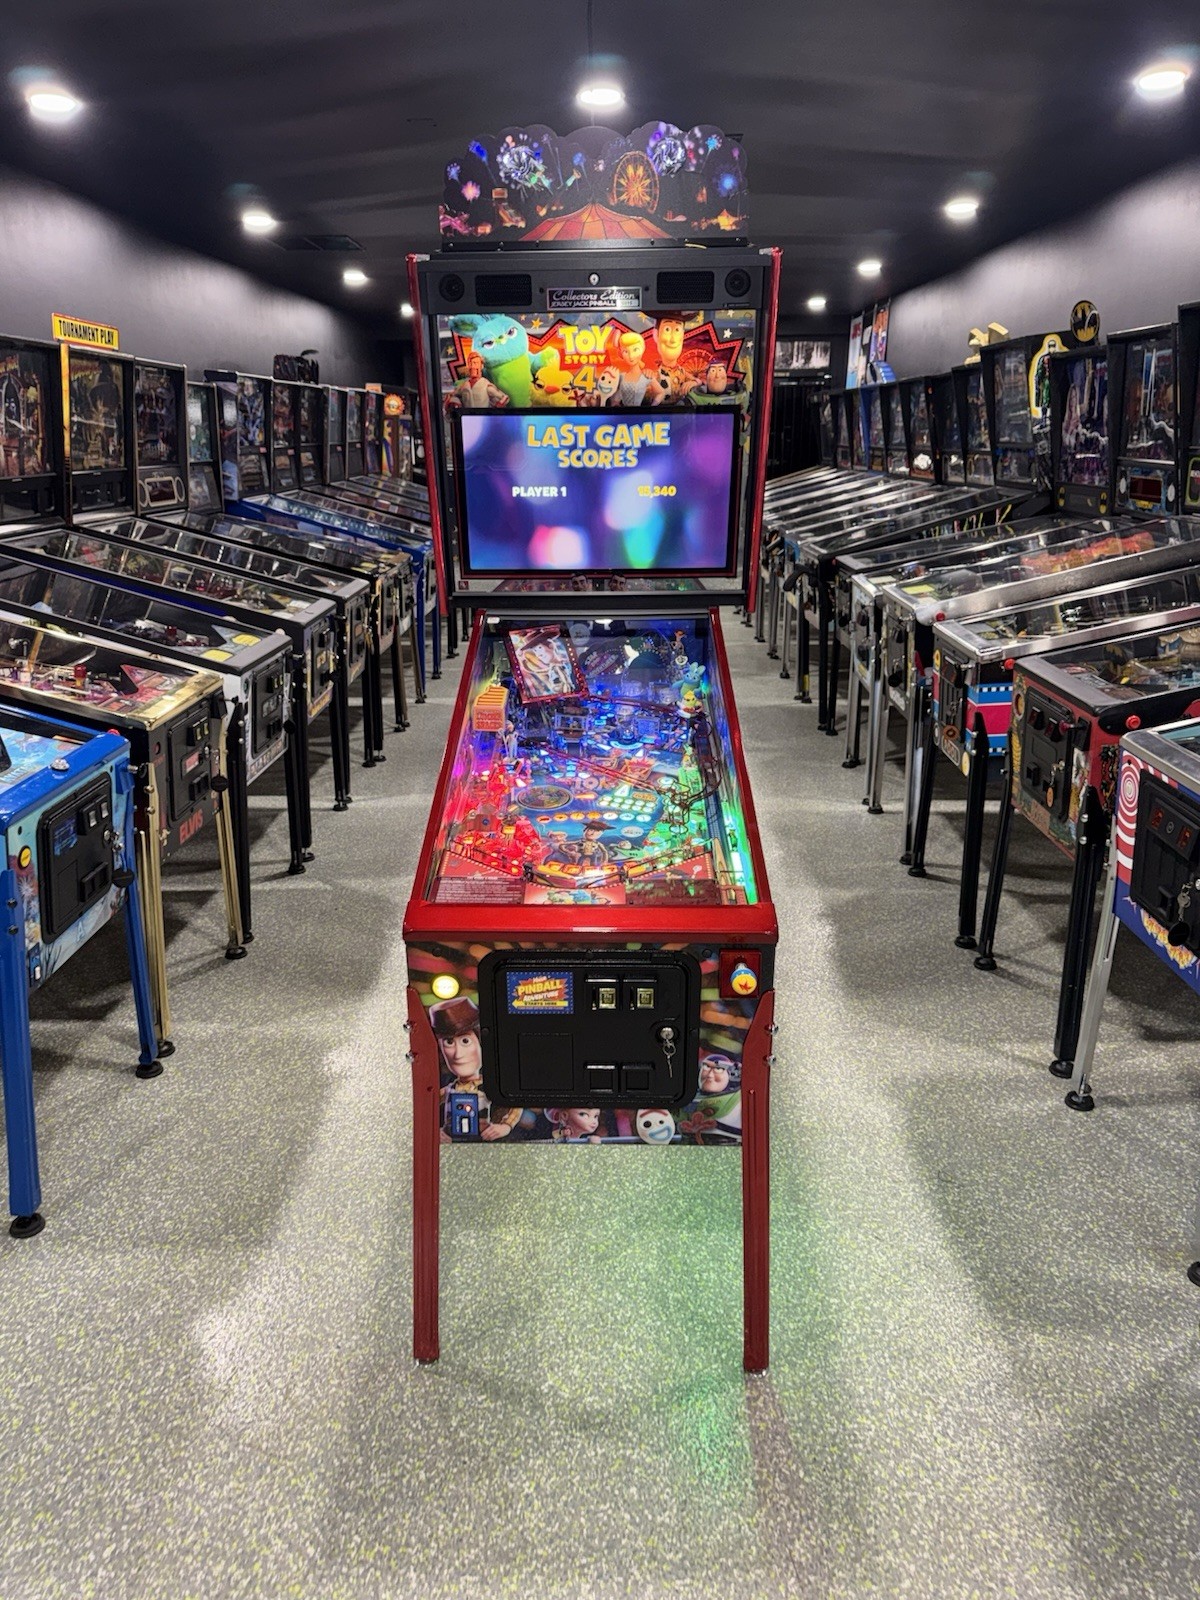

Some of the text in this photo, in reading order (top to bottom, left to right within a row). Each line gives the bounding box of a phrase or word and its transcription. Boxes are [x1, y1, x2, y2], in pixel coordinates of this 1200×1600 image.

[552, 288, 636, 301] Collectors Edition
[573, 300, 589, 308] JACK
[589, 300, 616, 308] PINBALL
[59, 320, 114, 345] TOURNAMENT PLAY
[558, 324, 614, 354] TOY
[564, 354, 607, 365] STORY
[573, 364, 597, 393] 4
[526, 421, 671, 449] LAST GAME
[557, 449, 639, 470] SCORES
[512, 486, 567, 498] PLAYER 1
[179, 808, 203, 844] ELVIS
[517, 979, 563, 996] PINBALL
